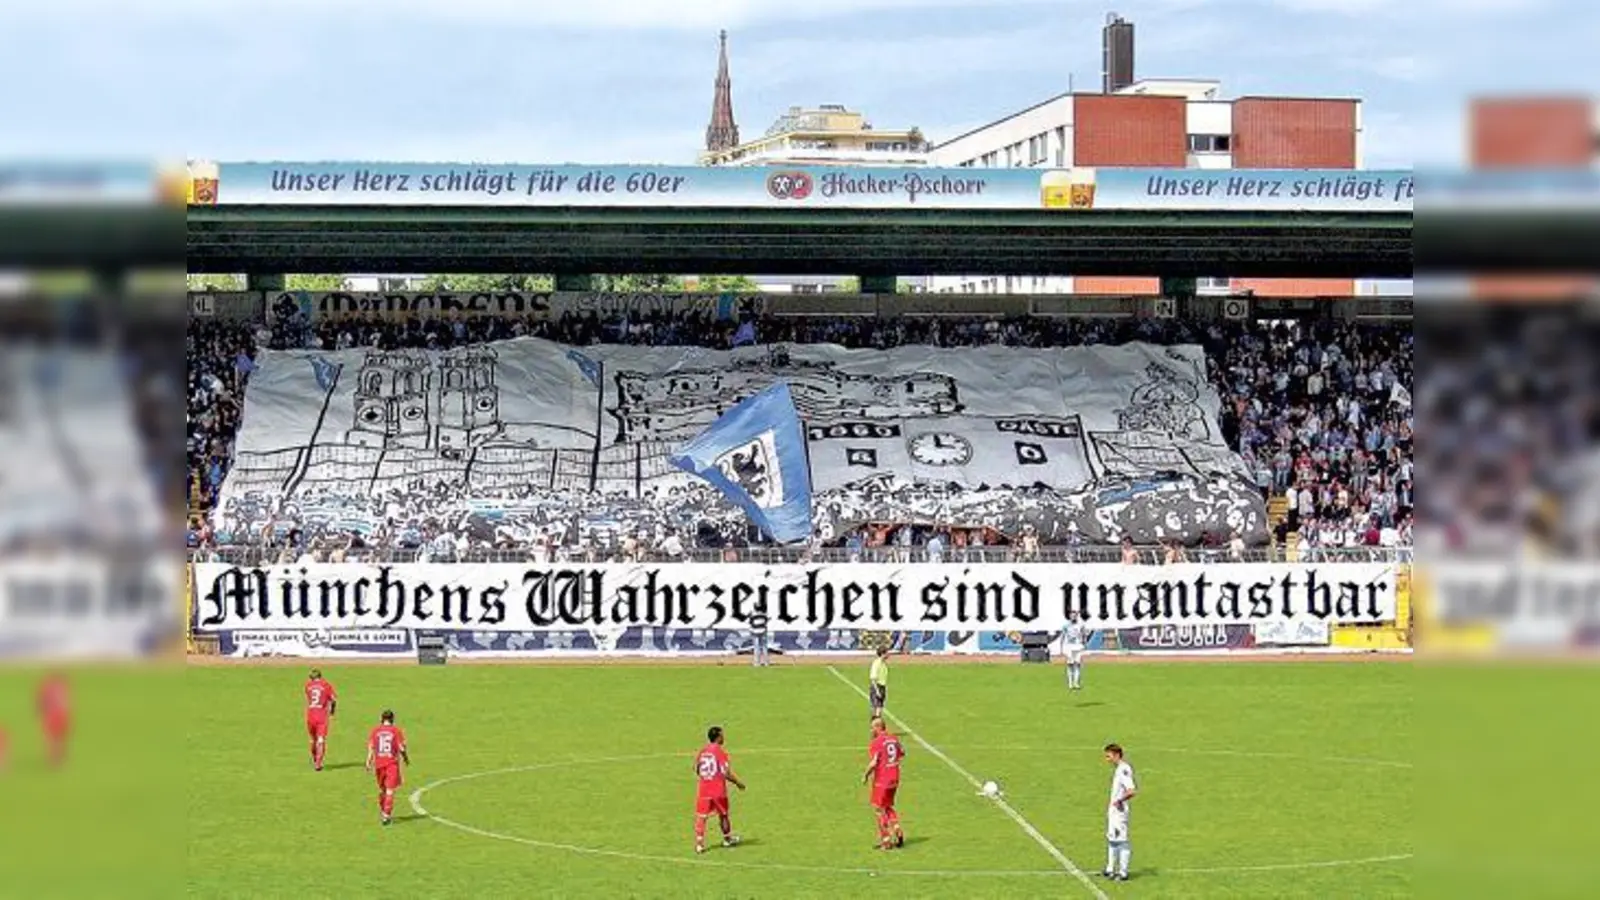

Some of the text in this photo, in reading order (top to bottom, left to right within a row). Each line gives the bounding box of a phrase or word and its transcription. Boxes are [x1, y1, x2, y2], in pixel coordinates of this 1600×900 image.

[272, 169, 685, 196] Unser Herz schlägt für die 60er
[820, 171, 987, 202] Hacker-Pschorr
[1147, 175, 1222, 196] Unser
[1226, 175, 1280, 197] Herz
[1290, 175, 1384, 201] schlägt
[202, 566, 1388, 629] Münchens Wahrzeichen sind unantastbar
[311, 689, 321, 705] 3
[699, 754, 717, 776] 20
[886, 743, 896, 762] 9
